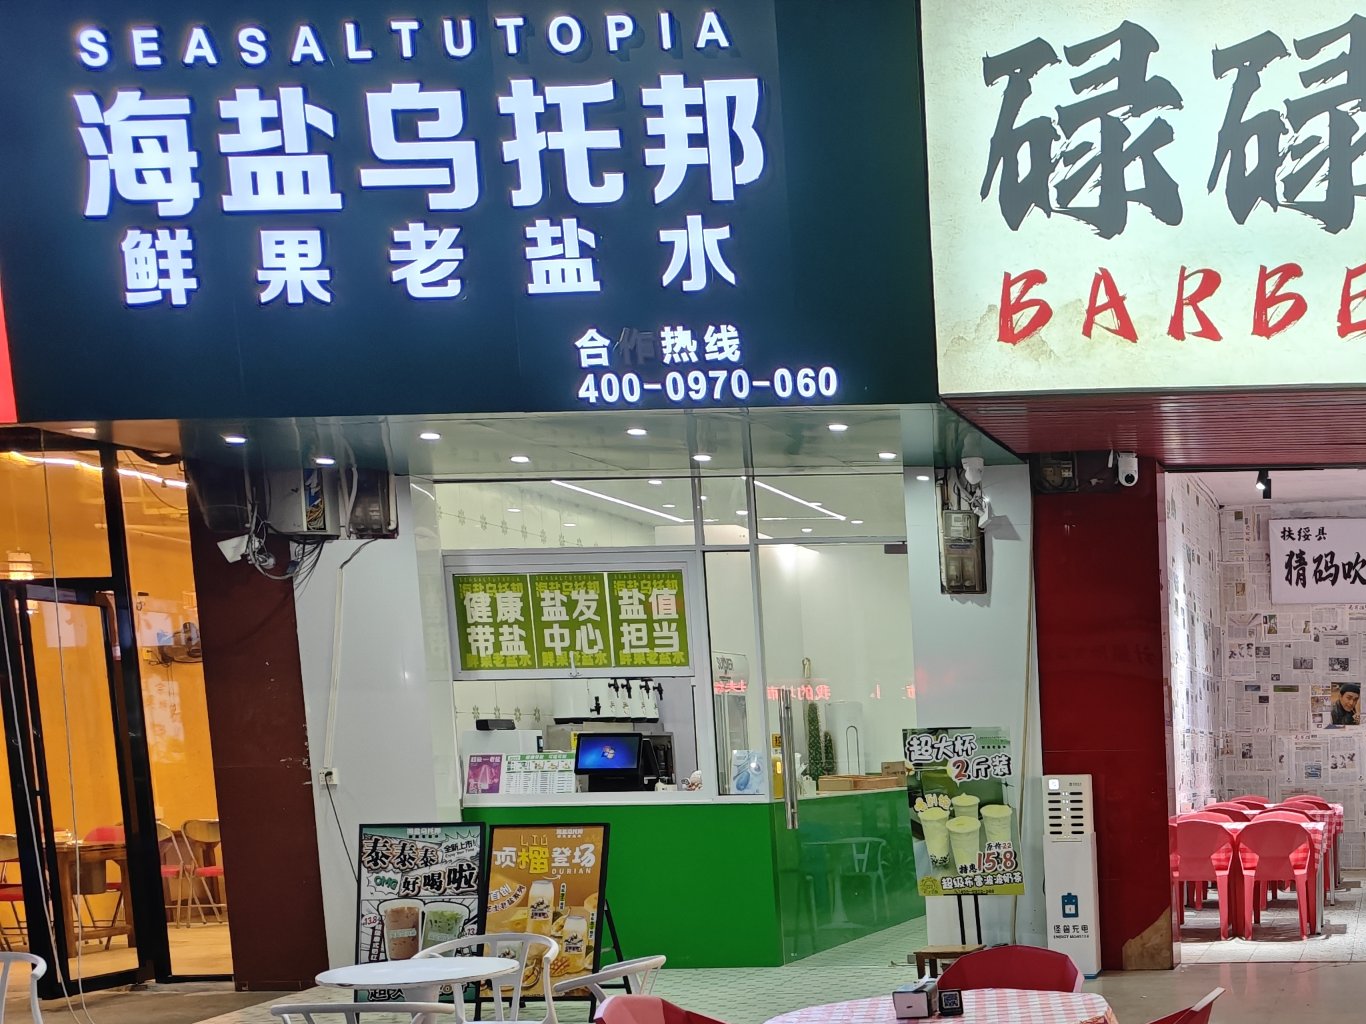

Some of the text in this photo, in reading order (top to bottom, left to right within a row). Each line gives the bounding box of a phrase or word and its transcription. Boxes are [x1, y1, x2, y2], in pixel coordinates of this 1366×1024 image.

[77, 11, 731, 69] SEASALTUTOPIA
[72, 74, 765, 218] 海盐乌托邦
[121, 214, 736, 305] 鲜果老盐水
[578, 367, 837, 403] 400-0970-060
[1280, 526, 1328, 542] 扶绥县
[464, 591, 524, 623] 健康
[540, 589, 600, 621] 盐发
[618, 588, 679, 620] 盐值
[467, 625, 528, 657] 带盐
[544, 623, 604, 656] 中心
[620, 621, 680, 653] 担当
[907, 735, 977, 762] 超大杯
[363, 838, 438, 867] 泰泰泰
[374, 876, 398, 890] OMG
[402, 863, 476, 892] 好喝啦
